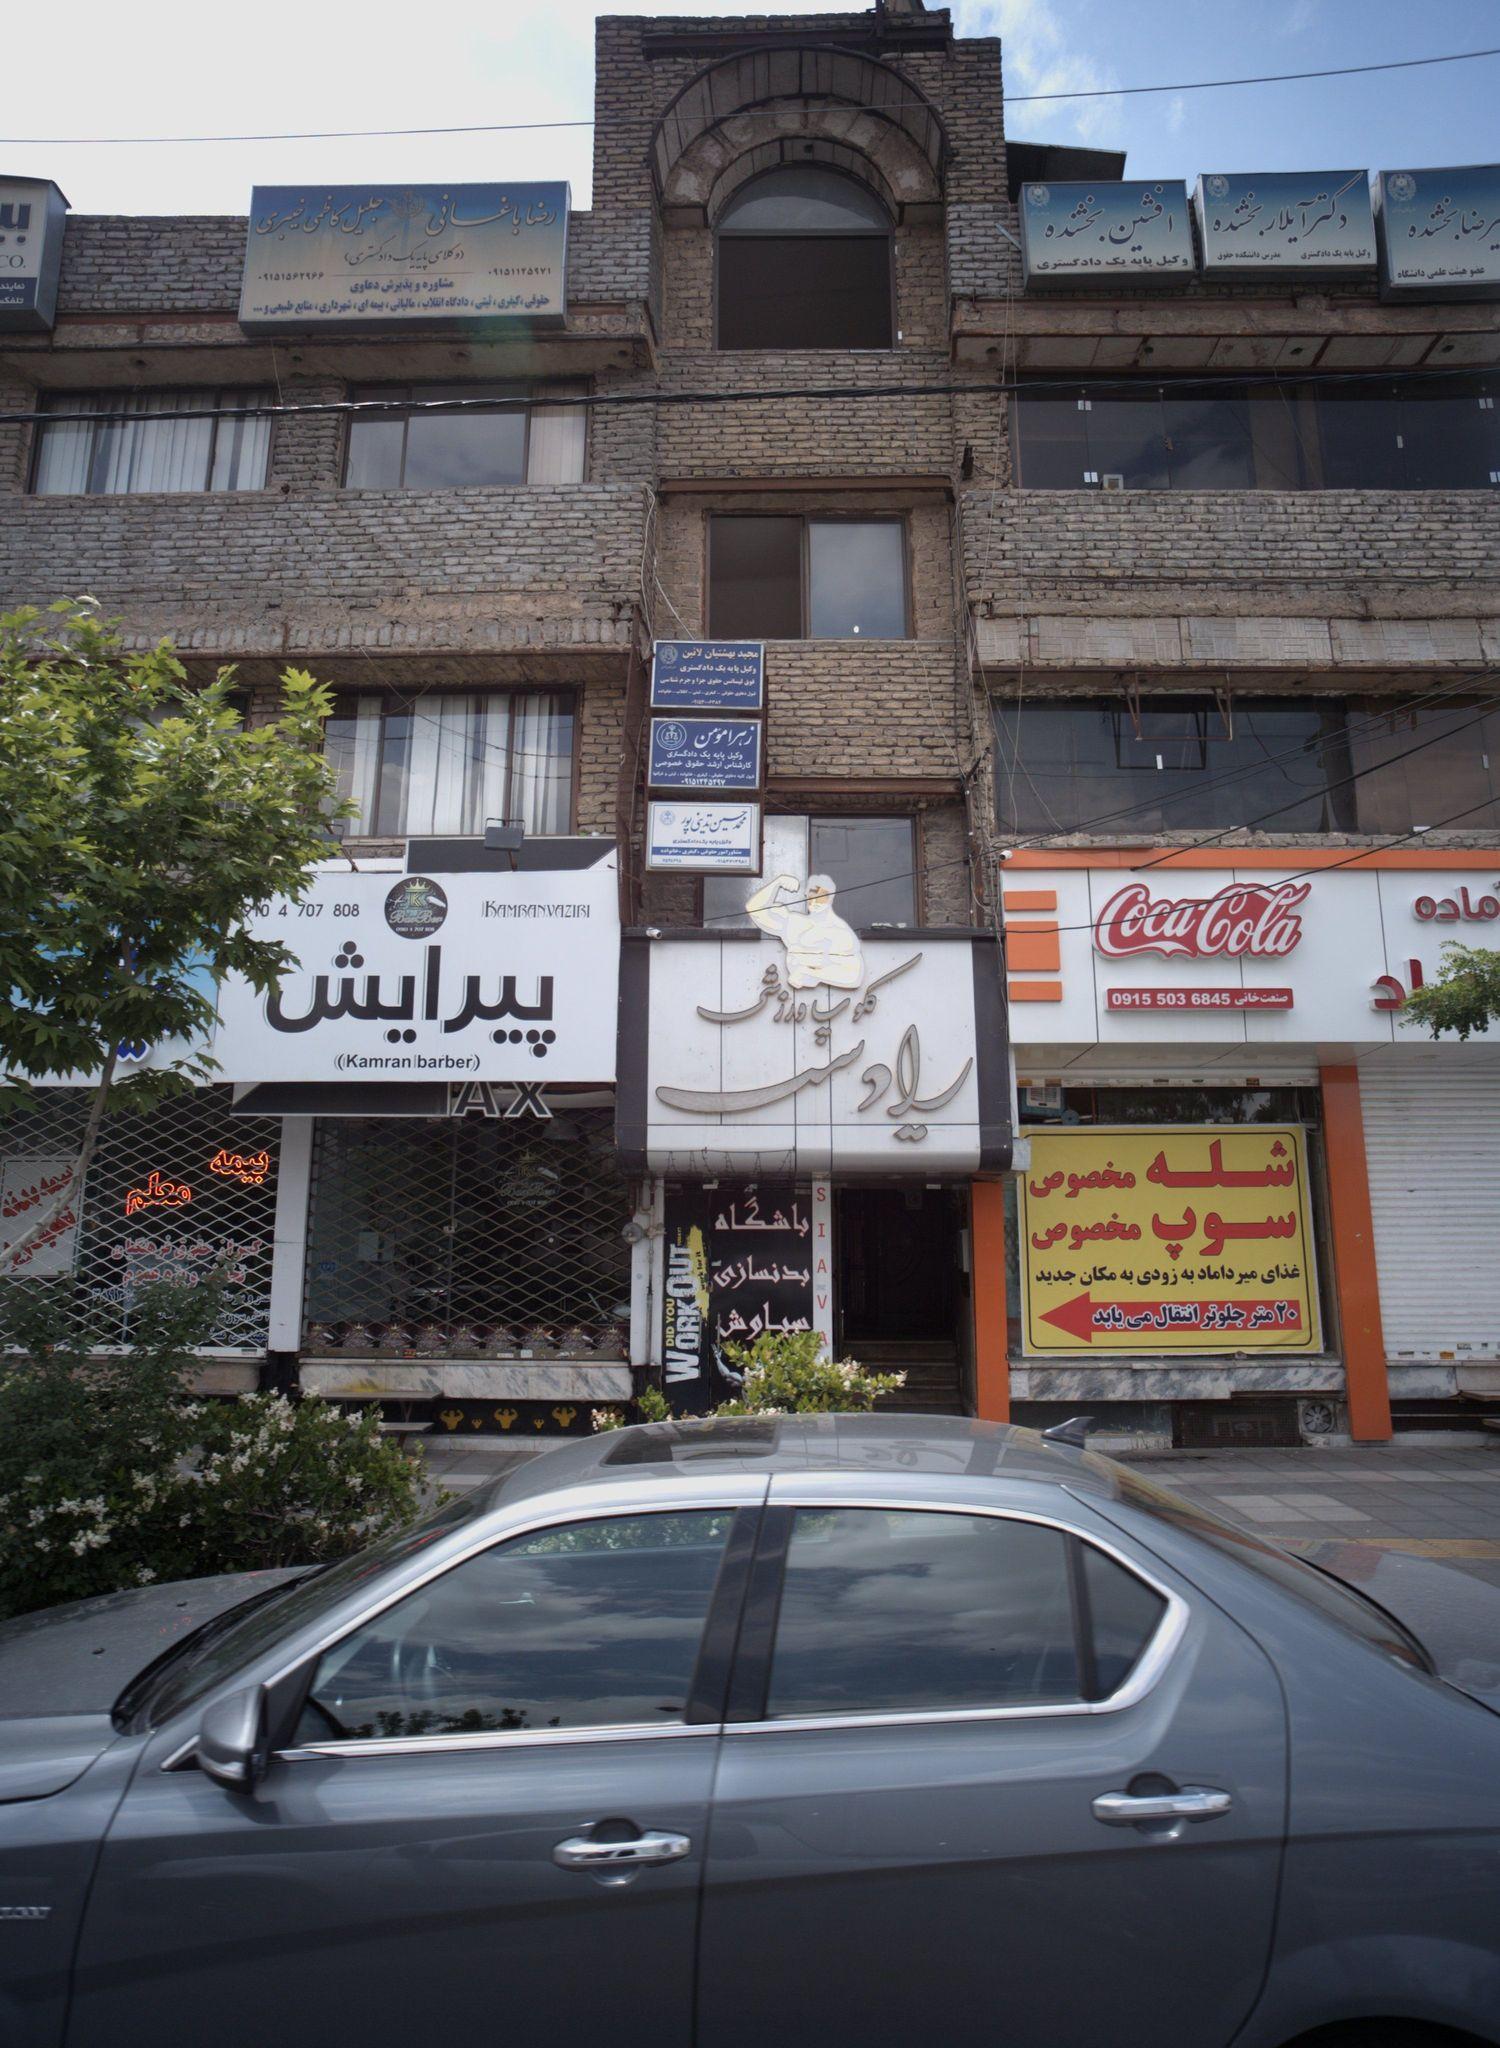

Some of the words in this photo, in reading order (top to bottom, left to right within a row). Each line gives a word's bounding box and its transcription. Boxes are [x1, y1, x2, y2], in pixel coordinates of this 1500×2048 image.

[303, 195, 351, 233] کاظمی
[525, 201, 556, 227] رضا
[1214, 193, 1264, 236] بخشنده
[1304, 172, 1364, 238] دکتر
[341, 197, 384, 235] جلیل
[1044, 196, 1105, 242] بخشنده
[1108, 185, 1173, 252] افشین
[1408, 196, 1459, 240] بخشنده
[1037, 258, 1101, 271] دادگستری
[1105, 257, 1126, 268] یک
[1131, 256, 1153, 268] پایه
[1156, 255, 1188, 267] وکیل
[1397, 268, 1425, 279] دانشگاه
[1427, 267, 1447, 280] علمی
[1470, 266, 1485, 277] عضو
[350, 279, 380, 293] دعاوی
[381, 278, 413, 293] پذیرش
[422, 278, 454, 292] مشاوره
[737, 650, 759, 660] مجید
[680, 664, 714, 673] دادگستری
[715, 665, 726, 673] یک
[727, 666, 740, 674] پایه
[740, 665, 756, 675] وکیل
[728, 726, 755, 746] زهرا
[655, 760, 683, 768] خصوصی
[666, 750, 698, 758] دادگستری
[699, 751, 711, 759] یک
[713, 752, 725, 761] پایه
[727, 752, 743, 760] وکیل
[685, 760, 705, 769] حقوق
[707, 761, 723, 769] ارشد
[724, 761, 752, 770] کارشناس
[242, 903, 270, 918] 910
[279, 904, 288, 917] 4
[298, 903, 324, 917] 707
[333, 903, 360, 917] 808
[1411, 886, 1500, 922] ماده
[1095, 883, 1312, 958] Coca-Cola
[265, 940, 556, 1058] پیرایش
[697, 963, 807, 1023] ورزشی
[1111, 992, 1152, 1006] 0915
[1156, 992, 1188, 1006] 503
[1190, 992, 1232, 1006] 6845
[336, 1054, 412, 1072] (Kamran
[416, 1054, 481, 1072] barber)
[206, 1149, 269, 1184] بیمه
[1146, 1139, 1296, 1189] شله
[1030, 1161, 1137, 1199] مخصوص
[714, 1195, 811, 1238] باشگاه
[1031, 1213, 1142, 1250] مخصوص
[1152, 1206, 1297, 1261] سوپ
[713, 1254, 811, 1290] بدنسازی
[1035, 1266, 1077, 1286] جدید
[1079, 1265, 1118, 1285] مکان
[1120, 1268, 1135, 1284] به
[1136, 1266, 1178, 1286] زودی
[1181, 1268, 1195, 1284] به
[1261, 1263, 1301, 1285] غذای
[665, 1298, 676, 1322] YOU
[1092, 1306, 1124, 1330] یابد
[1125, 1310, 1152, 1329] می
[1154, 1304, 1199, 1329] انتقال
[1200, 1306, 1245, 1330] جلوتر
[1248, 1304, 1274, 1328] متر
[1278, 1302, 1298, 1323] ۲۰
[719, 1301, 812, 1341] سیاوش
[665, 1326, 675, 1348] DID
